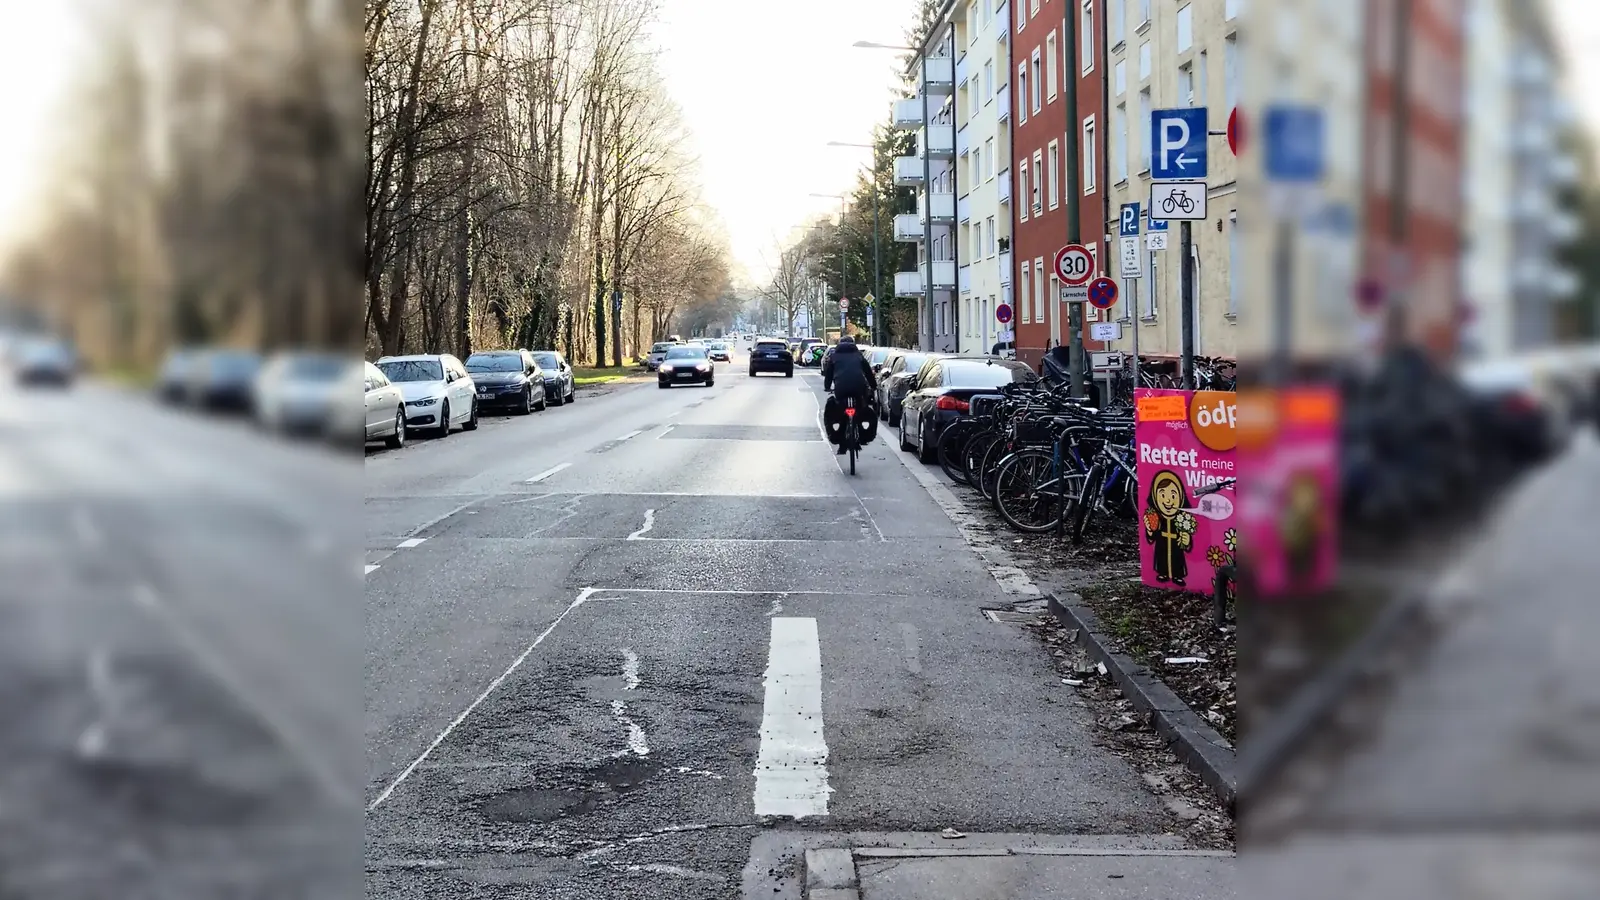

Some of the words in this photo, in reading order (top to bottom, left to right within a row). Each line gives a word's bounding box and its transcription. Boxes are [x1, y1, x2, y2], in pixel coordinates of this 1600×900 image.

[1161, 118, 1190, 169] P
[1123, 207, 1134, 232] P
[1063, 257, 1085, 274] 30
[1166, 421, 1188, 430] möglich
[1197, 400, 1236, 428] ödp
[1140, 443, 1198, 467] Rettet
[1201, 458, 1233, 470] meine
